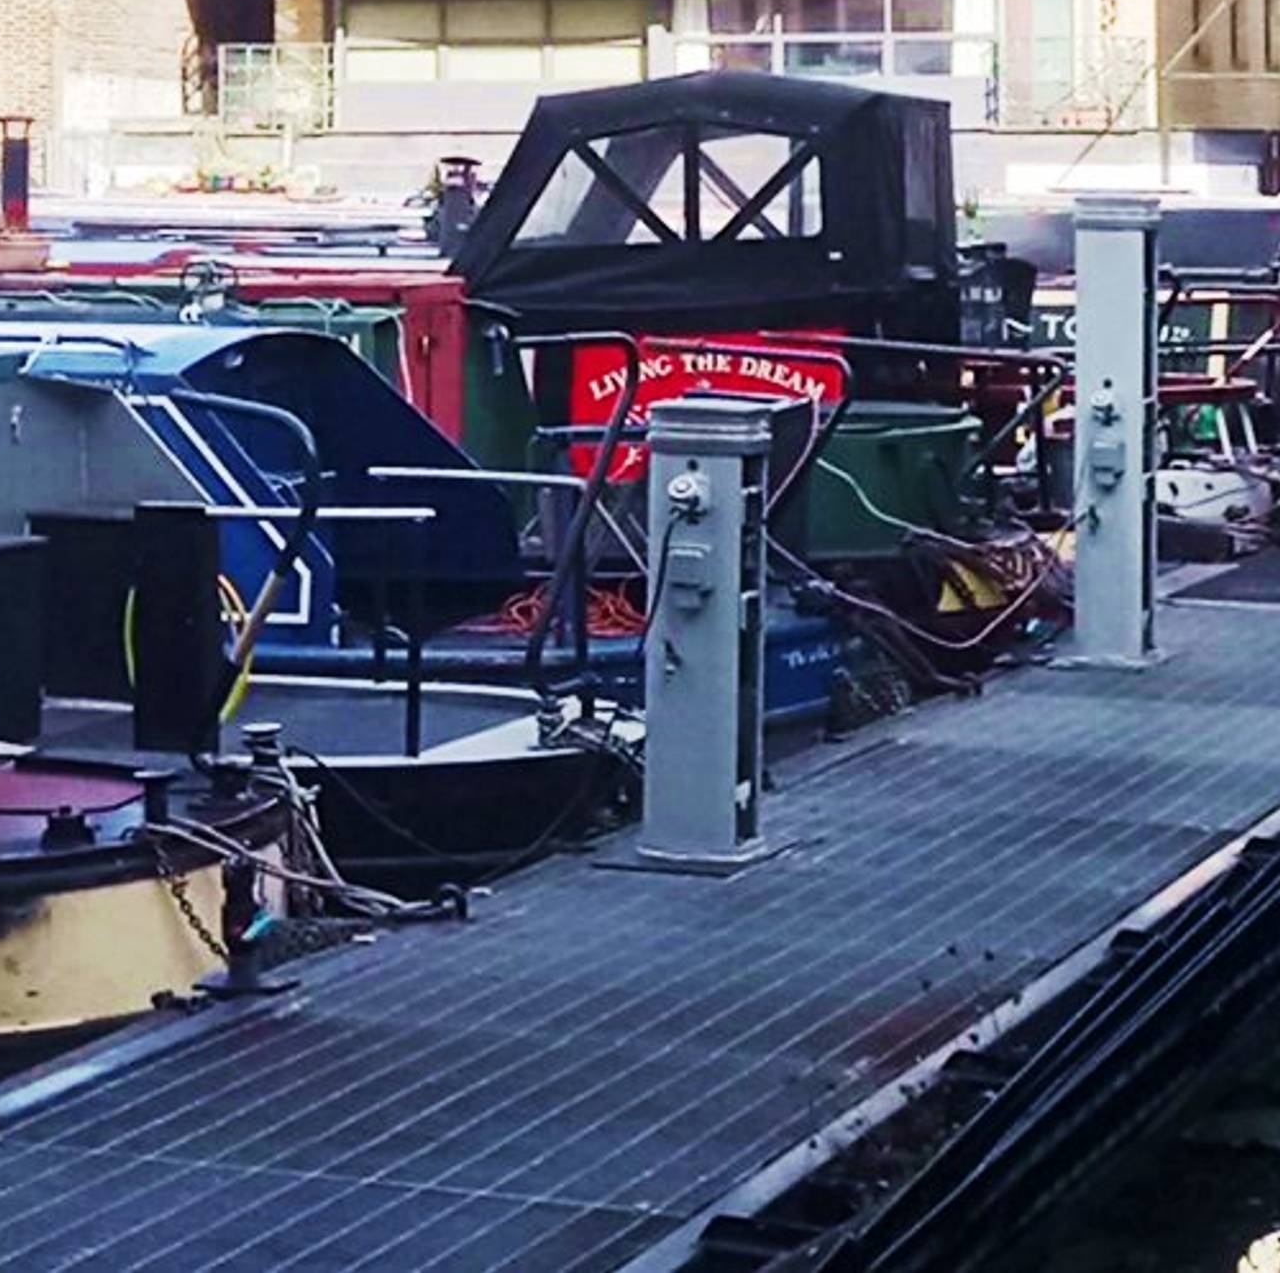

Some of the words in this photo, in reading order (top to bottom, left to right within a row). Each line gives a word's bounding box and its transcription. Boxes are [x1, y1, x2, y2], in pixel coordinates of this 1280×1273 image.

[588, 357, 672, 401] LIVNG
[679, 353, 731, 374] THE
[739, 356, 826, 400] DREAM
